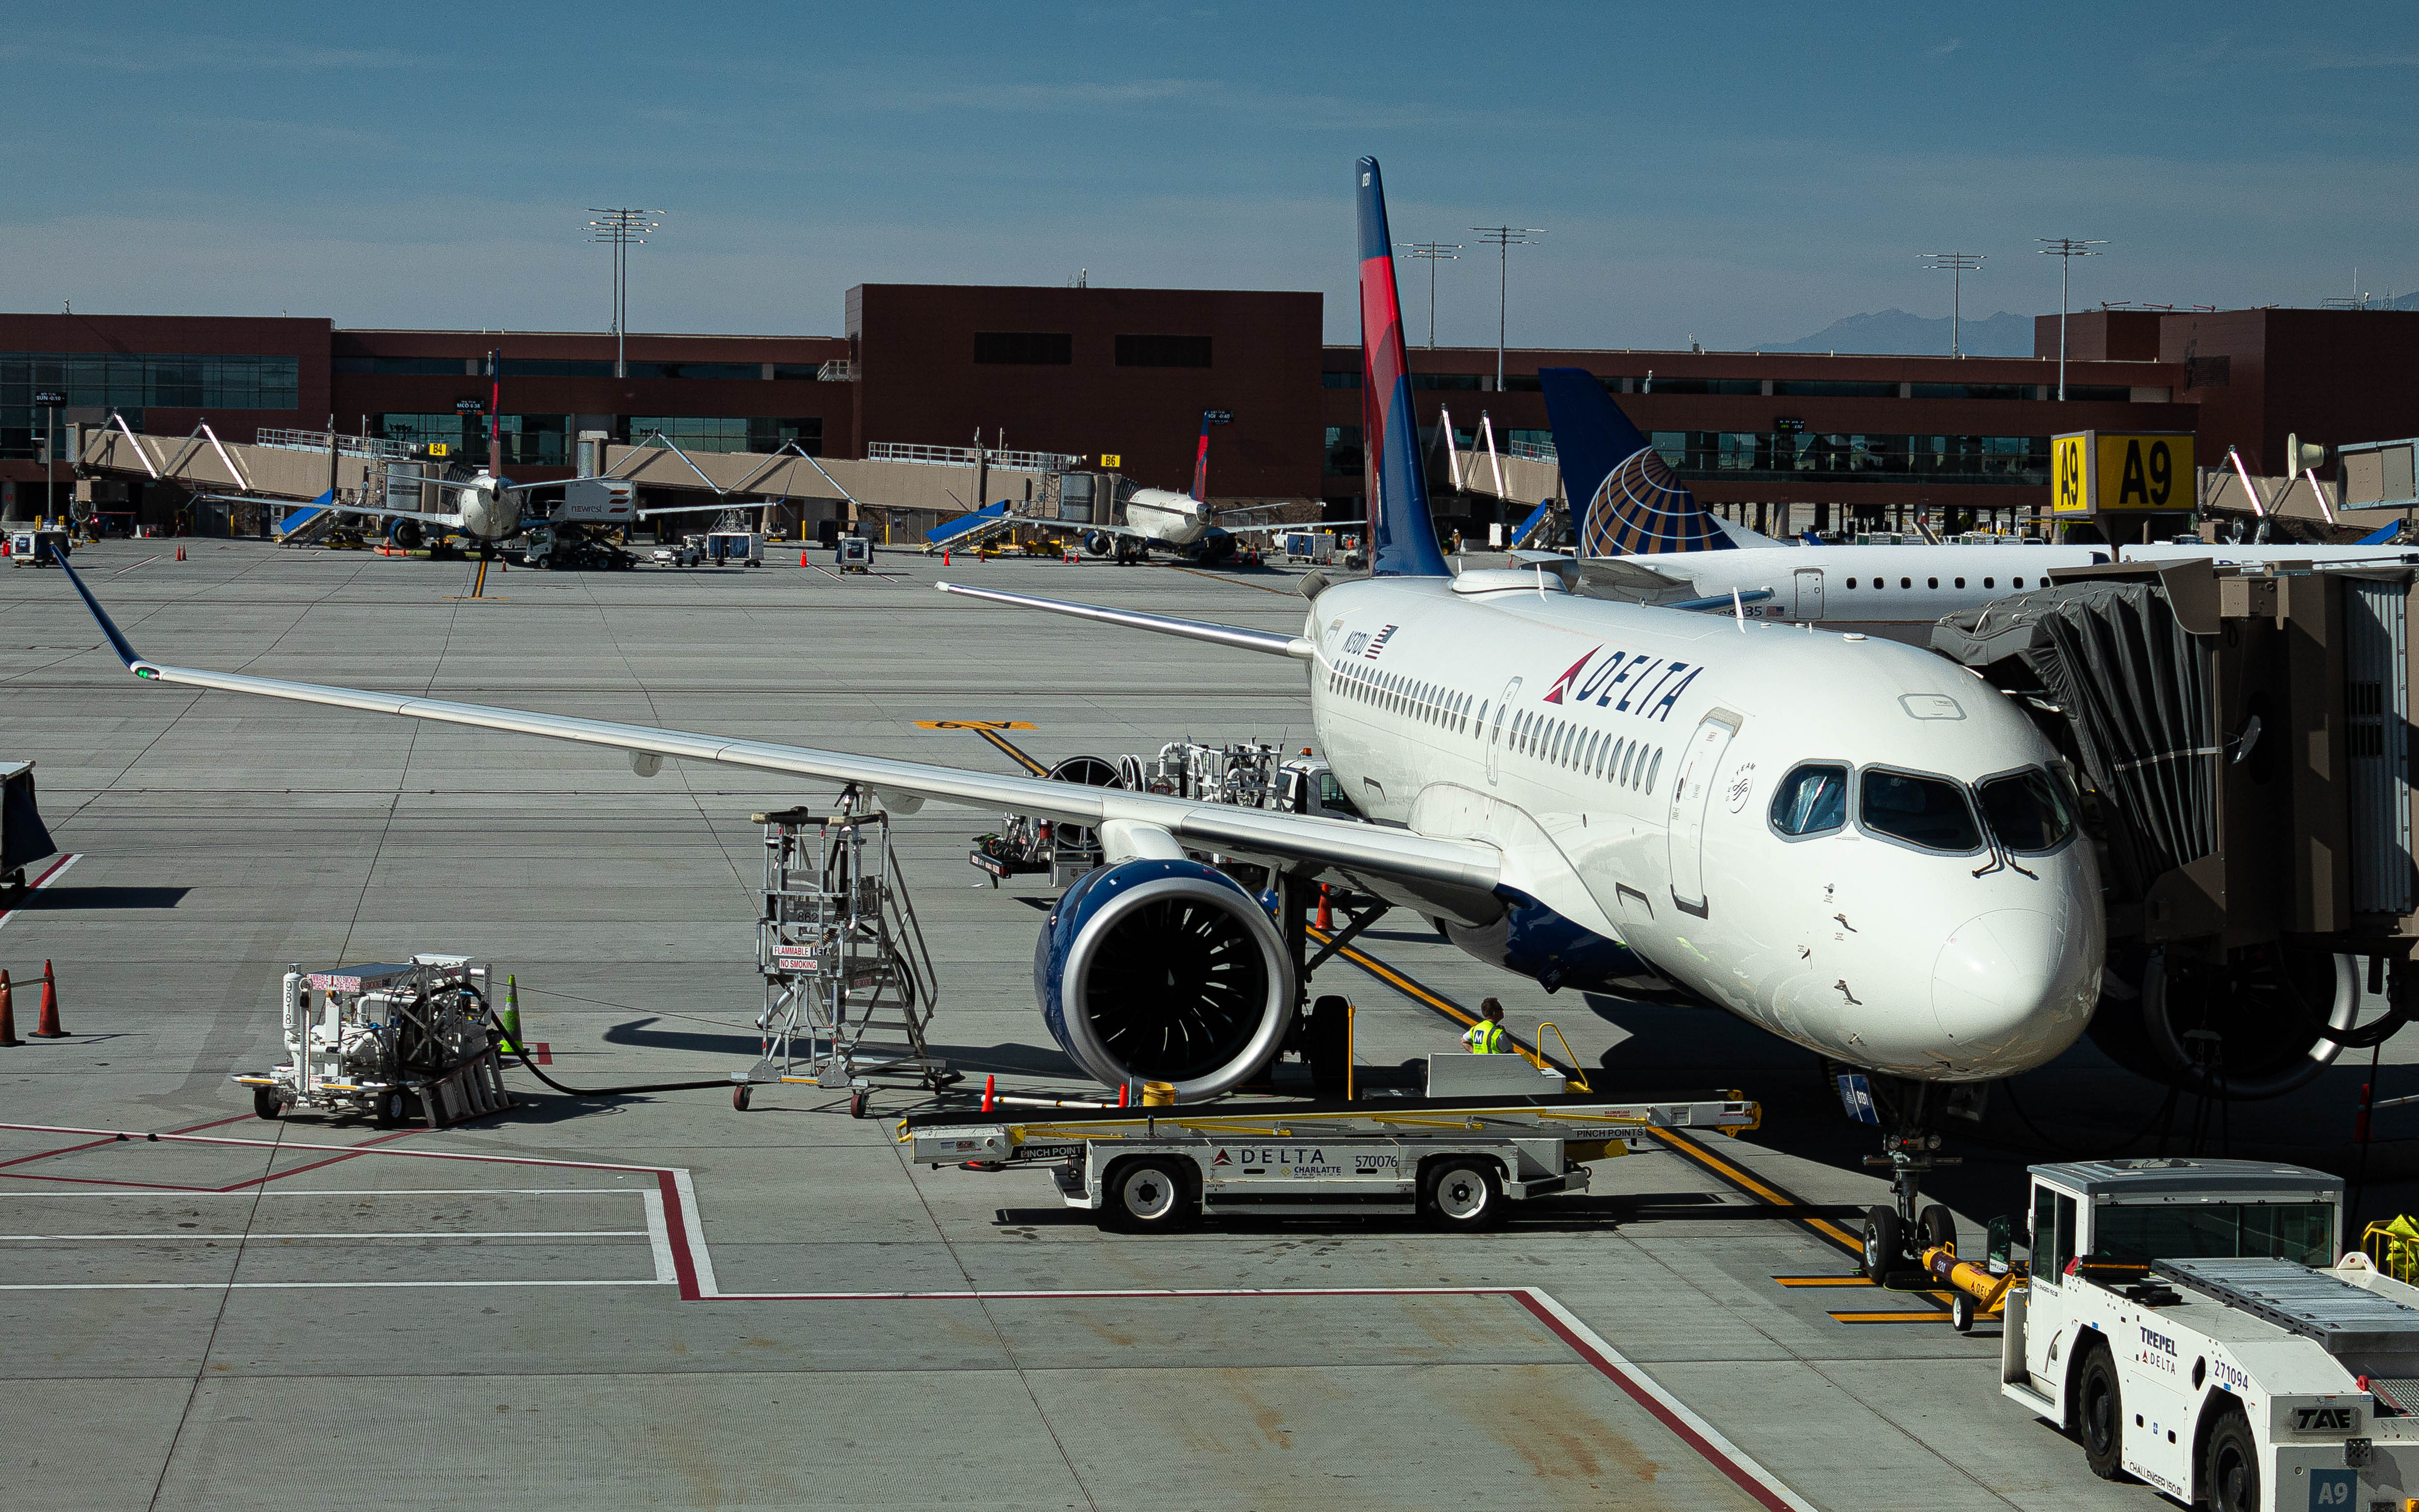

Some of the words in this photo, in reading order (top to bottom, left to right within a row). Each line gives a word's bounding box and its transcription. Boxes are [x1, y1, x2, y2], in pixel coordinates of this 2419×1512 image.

[433, 443, 443, 454] B4
[1106, 456, 1116, 466] B6
[2061, 441, 2078, 506] A9
[2119, 439, 2172, 505] A9
[1341, 630, 1372, 655] N131DU
[1575, 651, 1705, 722] DELTA
[797, 912, 818, 922] 862
[775, 946, 809, 956] FLAMMABLE
[790, 959, 816, 969] SMOKING
[1475, 1032, 1482, 1043] M
[1856, 1090, 1869, 1106] 8131
[1577, 1129, 1606, 1138] PINCH
[1608, 1128, 1643, 1137] POINTS
[1020, 1148, 1050, 1158] PINCH
[1241, 1148, 1325, 1164] DELTA
[1355, 1155, 1398, 1168] 570076
[1937, 1260, 1946, 1273] 220
[2140, 1326, 2178, 1357] TREPEL
[2150, 1352, 2176, 1375] DELTA
[2215, 1360, 2248, 1391] 271094
[2297, 1408, 2351, 1429] TAE
[2129, 1461, 2165, 1488] CHALLENGER
[2166, 1480, 2176, 1493] 150
[2318, 1483, 2348, 1504] A9
